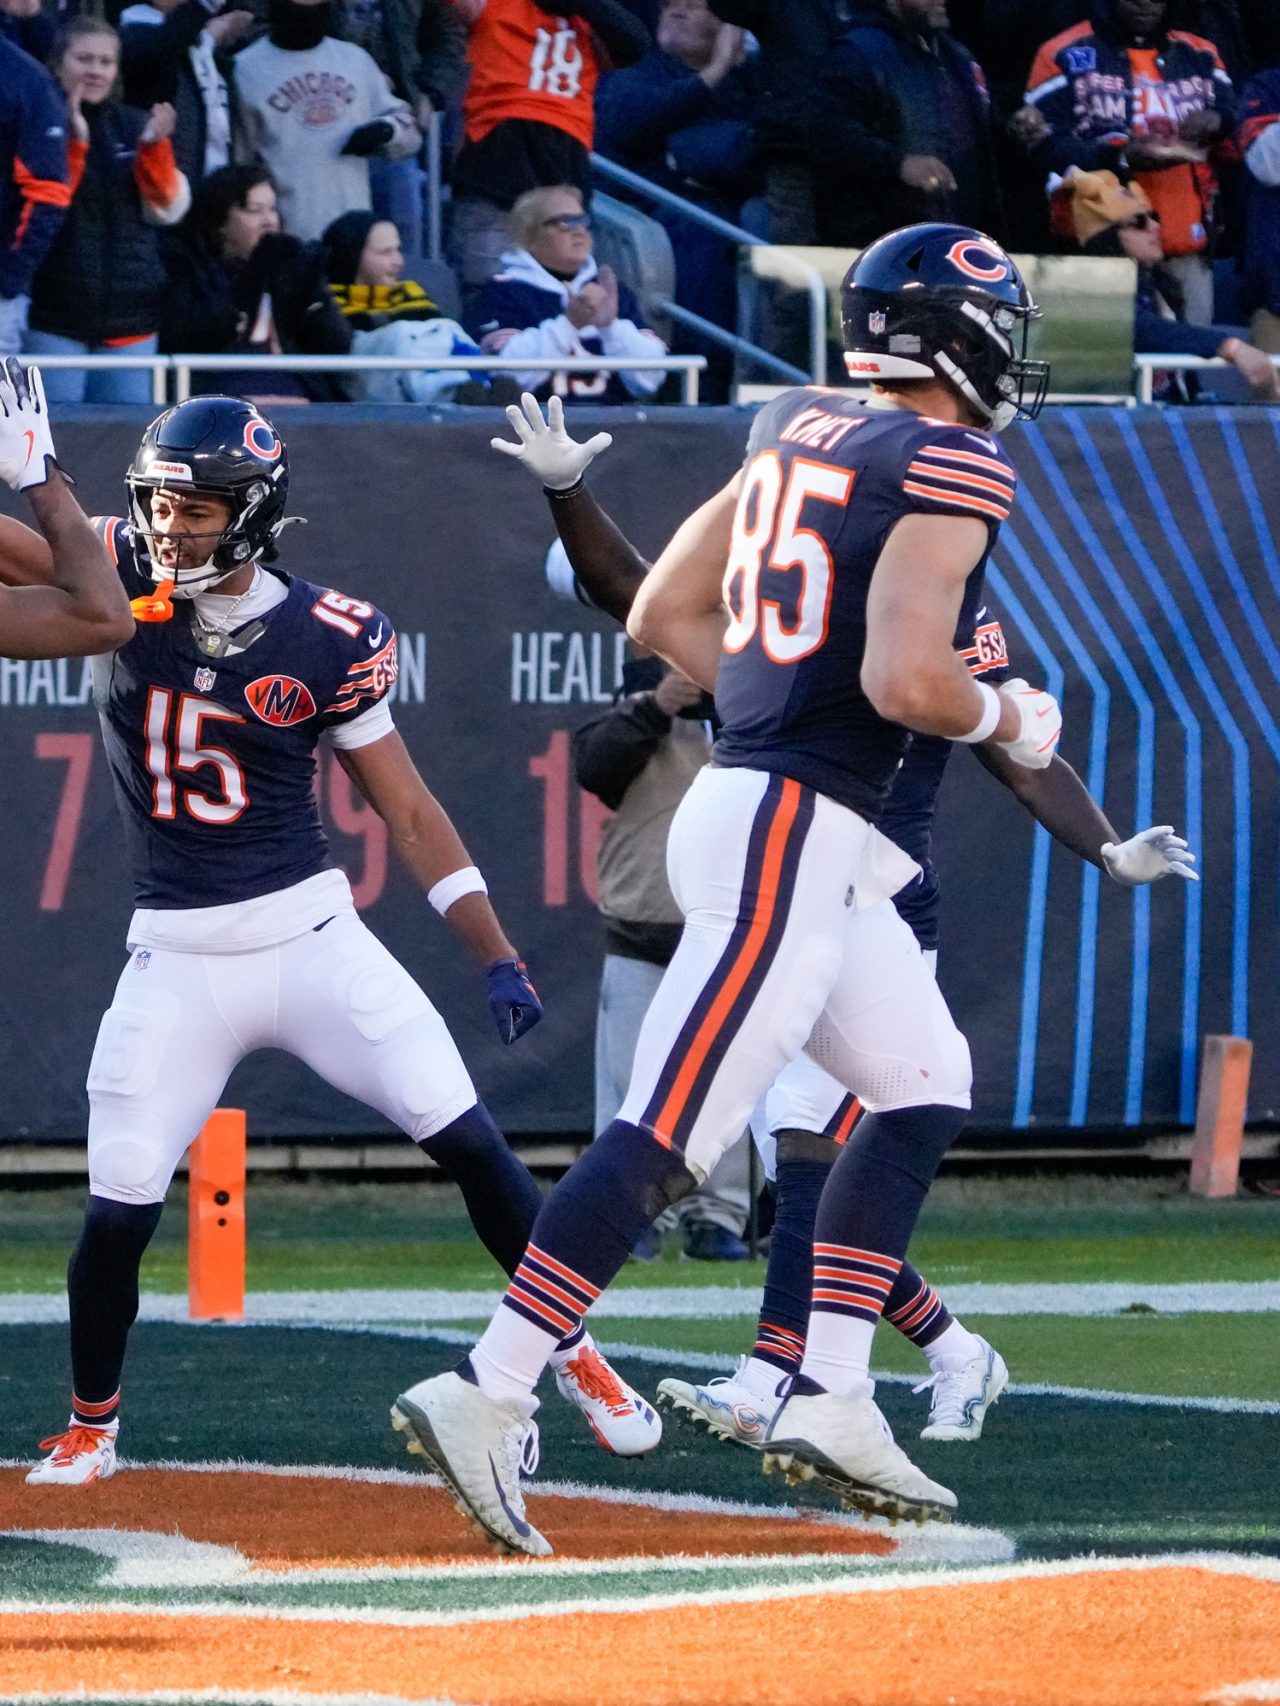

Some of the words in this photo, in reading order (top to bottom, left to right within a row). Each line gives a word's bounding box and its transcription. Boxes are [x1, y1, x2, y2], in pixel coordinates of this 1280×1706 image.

[528, 27, 584, 99] 18
[778, 407, 868, 451] KMET
[153, 463, 185, 474] BEARS
[722, 449, 856, 664] 85
[311, 591, 374, 639] 15
[144, 684, 250, 825] 15
[35, 733, 94, 911] 7
